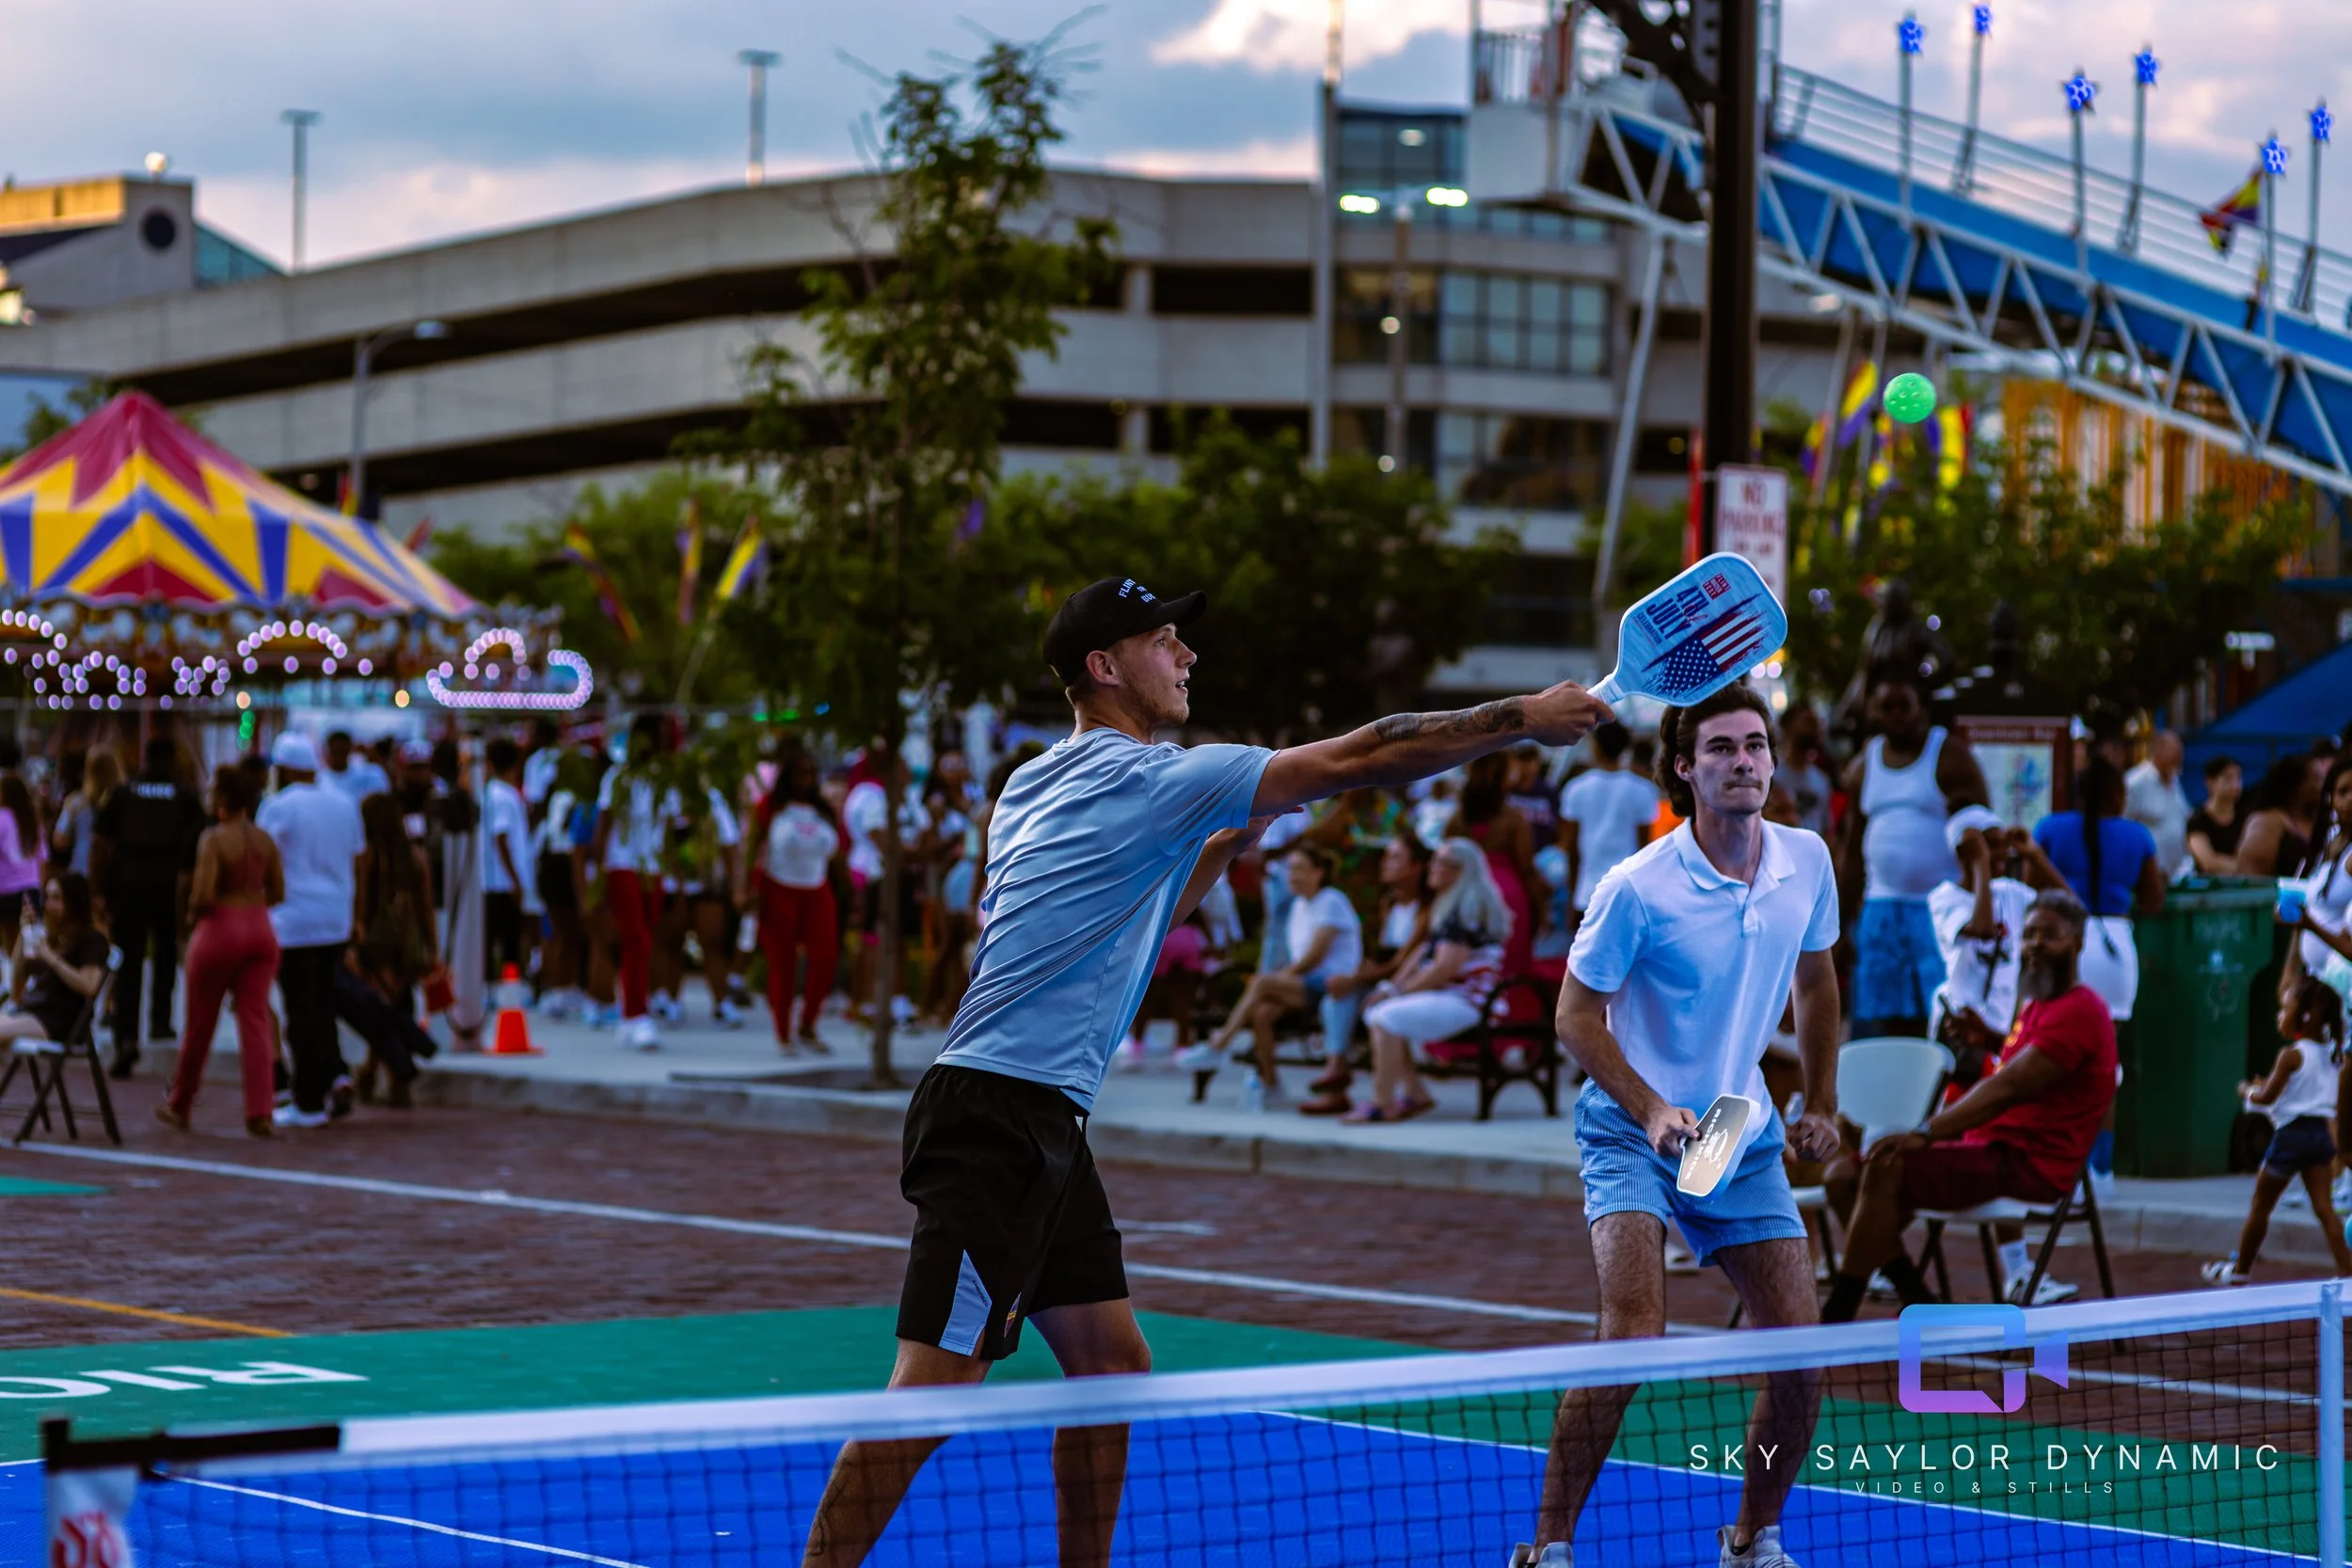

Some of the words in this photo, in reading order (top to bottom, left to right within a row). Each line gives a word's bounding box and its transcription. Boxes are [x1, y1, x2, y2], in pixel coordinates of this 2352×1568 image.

[1740, 480, 1768, 508] NO
[1723, 509, 1785, 536] PARKING
[1119, 578, 1136, 598] FLINT
[1704, 581, 1718, 597] FEST
[1715, 573, 1731, 591] FLINT
[1677, 586, 1709, 618] 4TH
[1636, 611, 1663, 646] CELEBRATION
[1646, 596, 1692, 641] JULY
